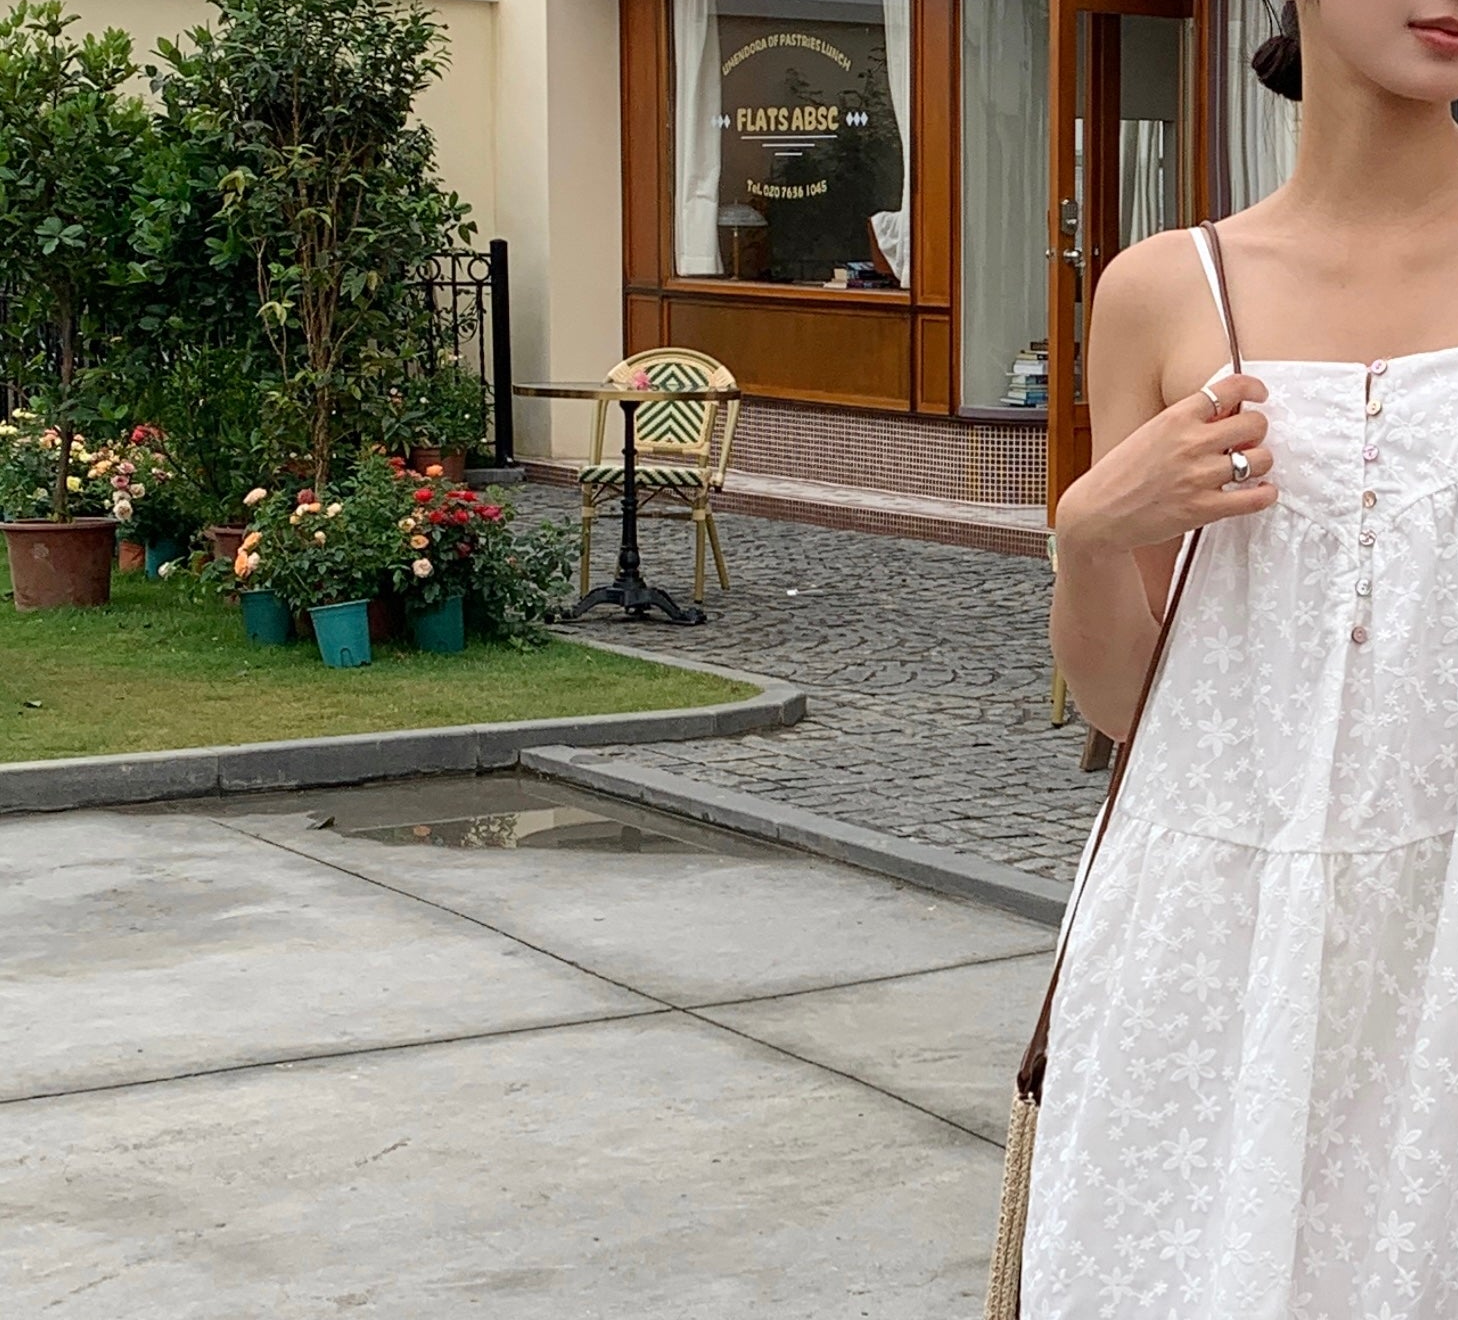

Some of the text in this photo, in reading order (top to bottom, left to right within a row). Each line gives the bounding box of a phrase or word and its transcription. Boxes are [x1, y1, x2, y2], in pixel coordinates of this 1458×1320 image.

[768, 35, 779, 48] OF
[780, 34, 821, 52] PASTRIES
[821, 41, 852, 72] LUNCH
[737, 106, 839, 131] FLATS ABSC
[763, 184, 780, 198] 020
[781, 185, 804, 199] 7636
[806, 180, 828, 196] 1045
